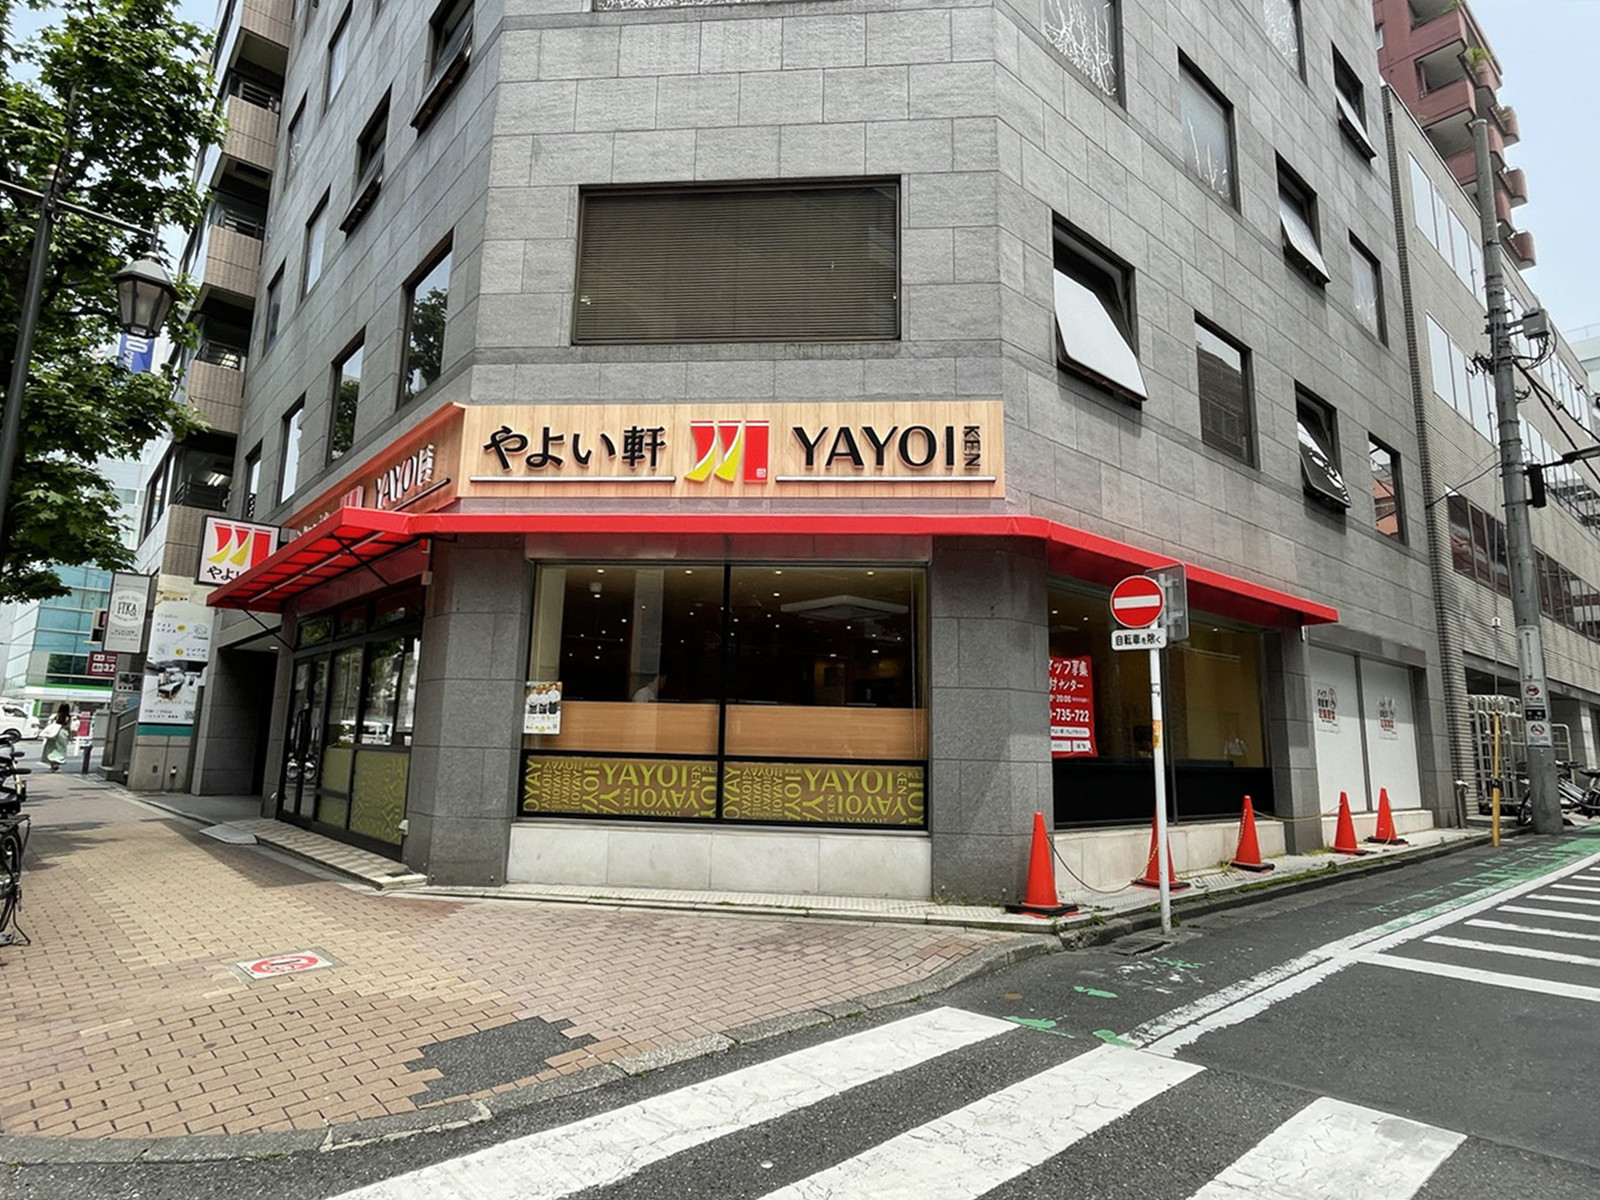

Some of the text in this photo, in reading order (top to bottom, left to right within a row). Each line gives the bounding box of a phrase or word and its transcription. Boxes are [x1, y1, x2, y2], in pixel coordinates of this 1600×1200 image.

[483, 425, 667, 471] やよい軒
[792, 425, 981, 470] YAYOI KEN
[1115, 633, 1161, 646] 自転車を除く
[1050, 708, 1089, 722] -735-722
[602, 763, 701, 789] YAYOI KEN
[803, 768, 907, 795] YAYOI KEN
